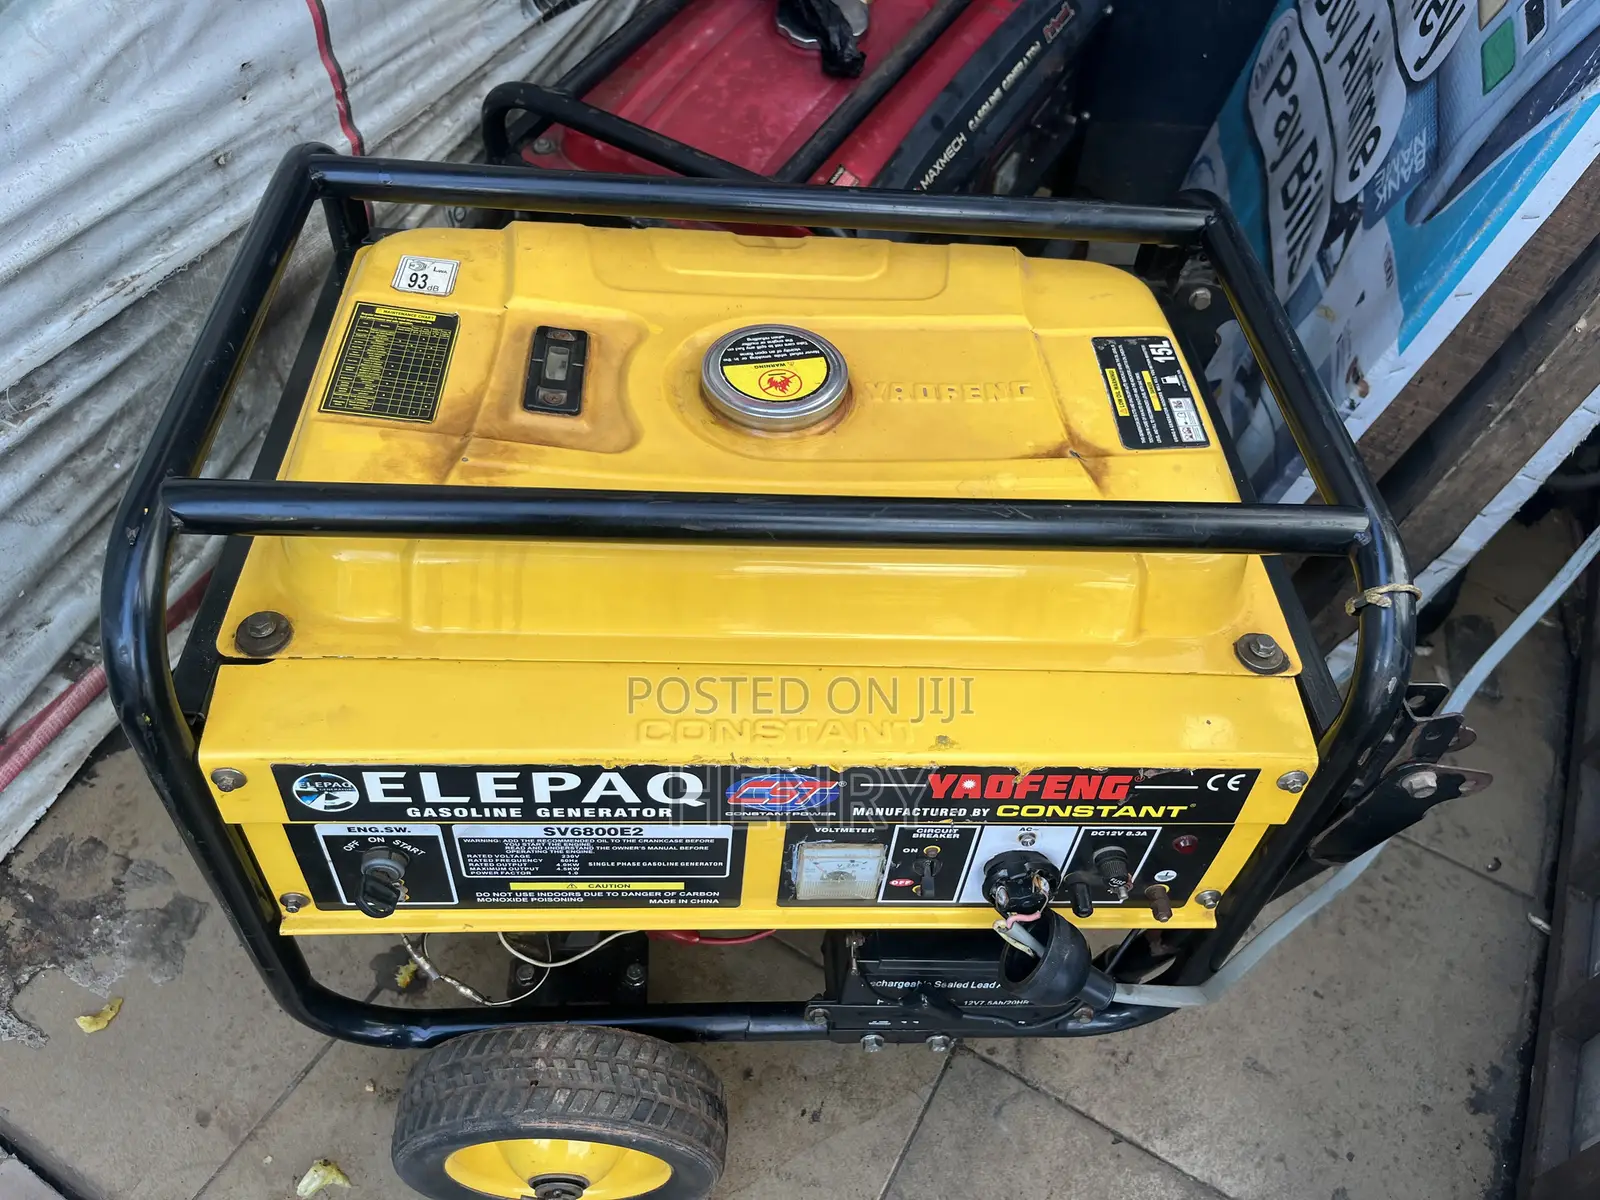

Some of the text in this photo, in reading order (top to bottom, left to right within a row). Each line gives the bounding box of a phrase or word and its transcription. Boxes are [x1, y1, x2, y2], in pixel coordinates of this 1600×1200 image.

[1338, 13, 1383, 182] Airtime
[1262, 49, 1304, 173] Pay
[919, 132, 968, 190] MAXMECH
[1375, 145, 1426, 212] BANK
[1280, 137, 1324, 285] Bills
[408, 272, 428, 289] 93
[383, 309, 417, 318] MAINTENANCE
[1148, 340, 1175, 363] 15L
[636, 718, 922, 746] CONSTANT
[362, 771, 706, 807] ELEPAQ
[928, 774, 1133, 800] YAOFENG
[1206, 774, 1246, 792] CE
[406, 807, 672, 818] GASOLINE GENERATOR
[852, 807, 990, 818] MANUFACTURED BY
[996, 804, 1188, 818] CONSTANT
[543, 827, 644, 837] SV6800E2
[343, 840, 360, 852] OFF
[392, 840, 426, 856] START
[934, 981, 969, 989] Sealed
[970, 981, 996, 989] Lead
